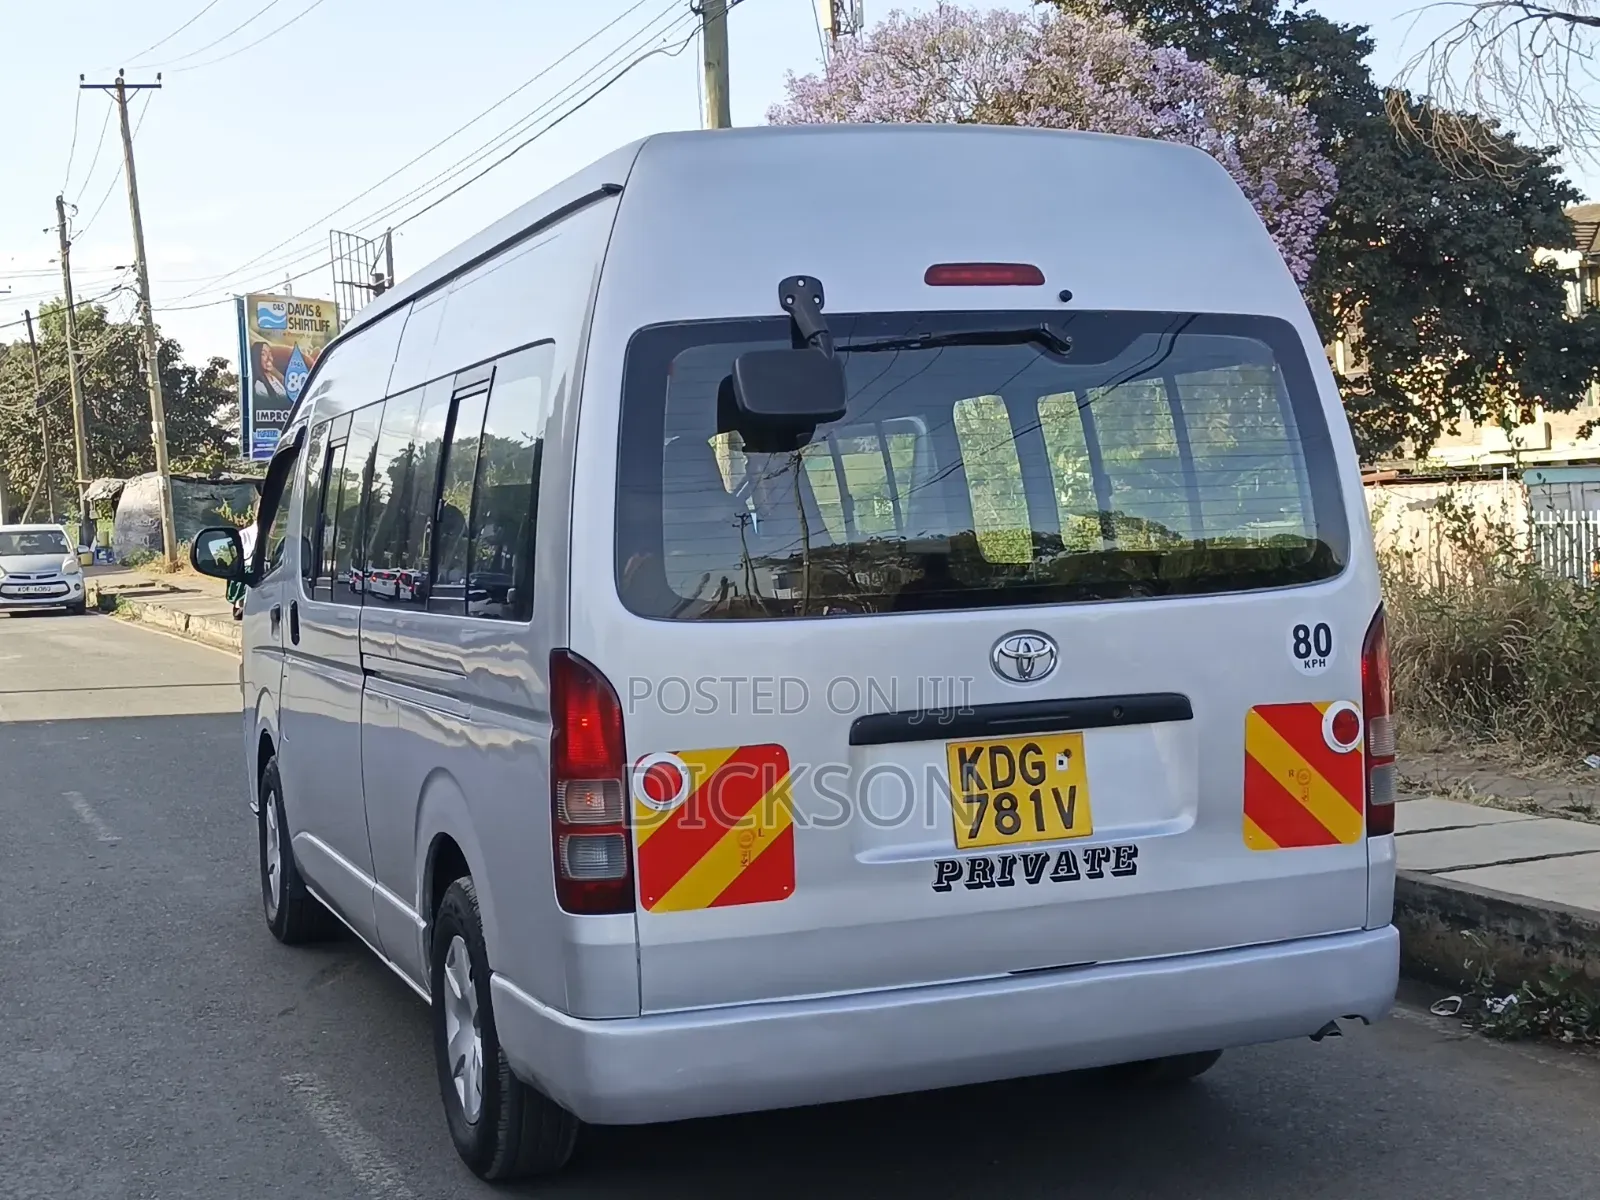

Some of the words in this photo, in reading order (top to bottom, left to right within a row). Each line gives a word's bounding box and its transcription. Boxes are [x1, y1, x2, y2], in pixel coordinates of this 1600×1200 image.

[272, 303, 285, 311] D&S
[287, 302, 314, 317] DAVIS
[315, 305, 322, 318] &
[288, 317, 331, 333] SHIRTLIFF
[1292, 622, 1333, 660] 80
[1303, 658, 1327, 669] KPH
[957, 742, 1047, 792] KDG
[963, 785, 1077, 840] 781V
[932, 844, 1139, 892] PRIVATE
